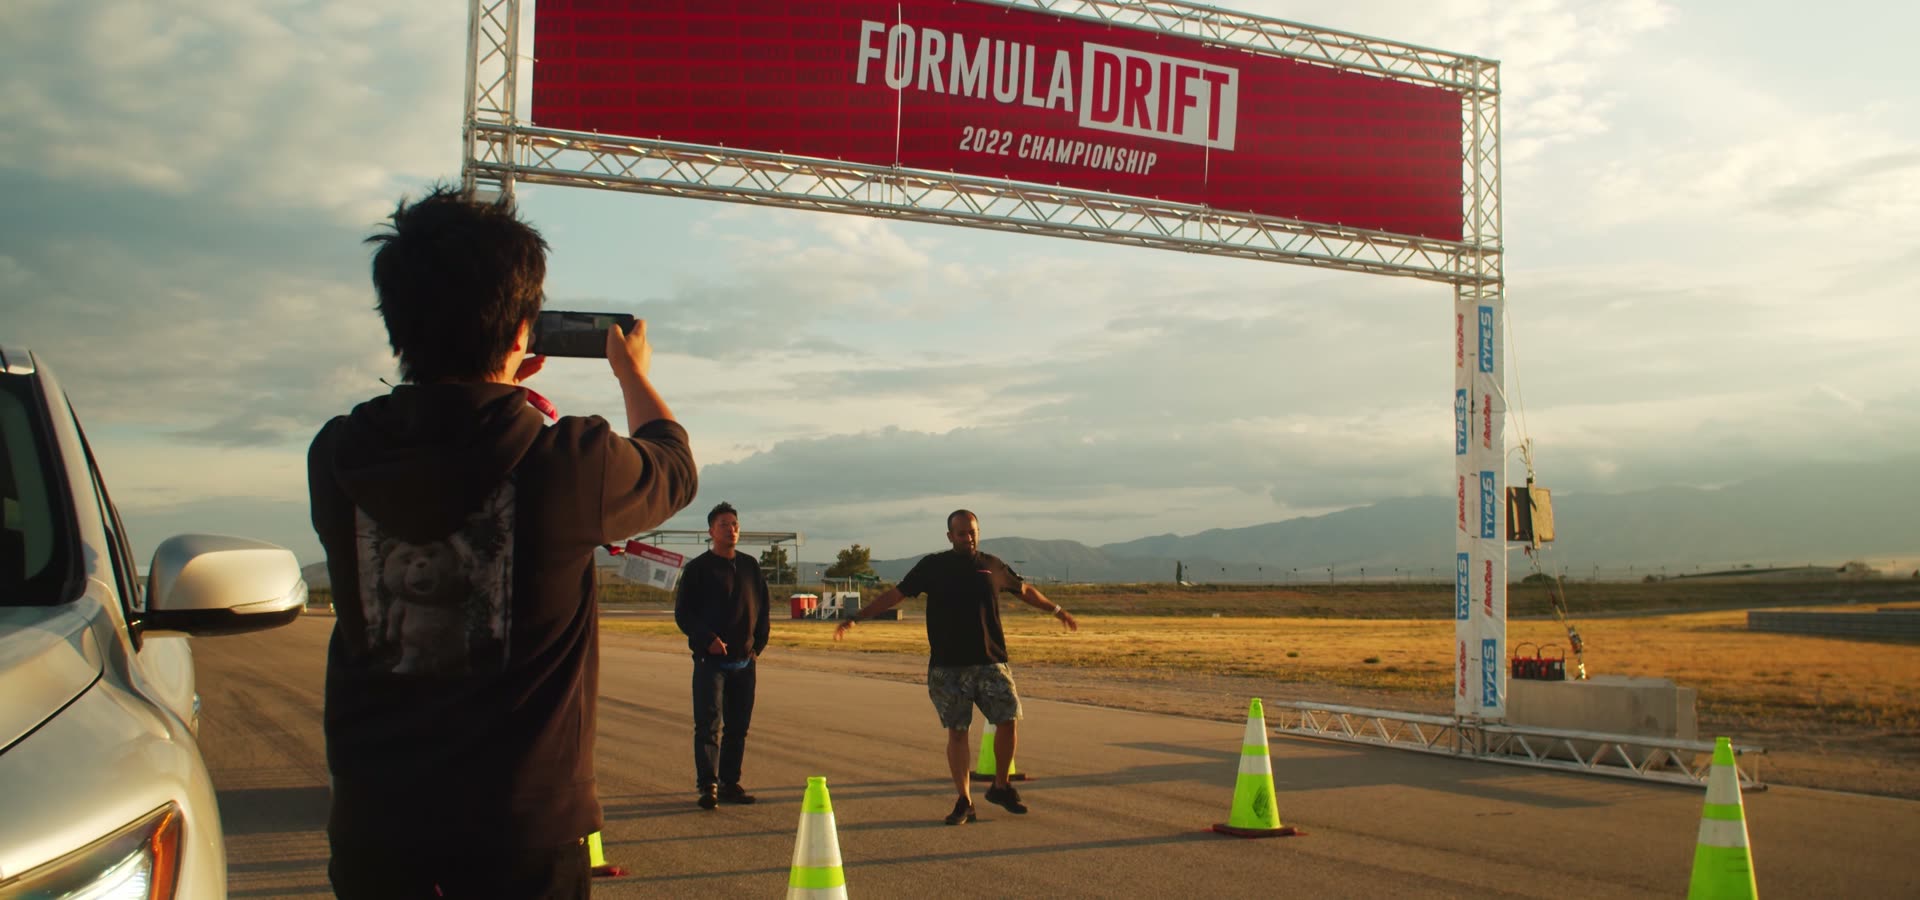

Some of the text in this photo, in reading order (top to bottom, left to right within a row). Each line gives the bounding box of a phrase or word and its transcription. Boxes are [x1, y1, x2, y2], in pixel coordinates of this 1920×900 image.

[856, 19, 1074, 113] FORMULA
[1090, 50, 1229, 142] DRIFT
[959, 126, 1157, 175] 2022 CHAMPIONSHIP
